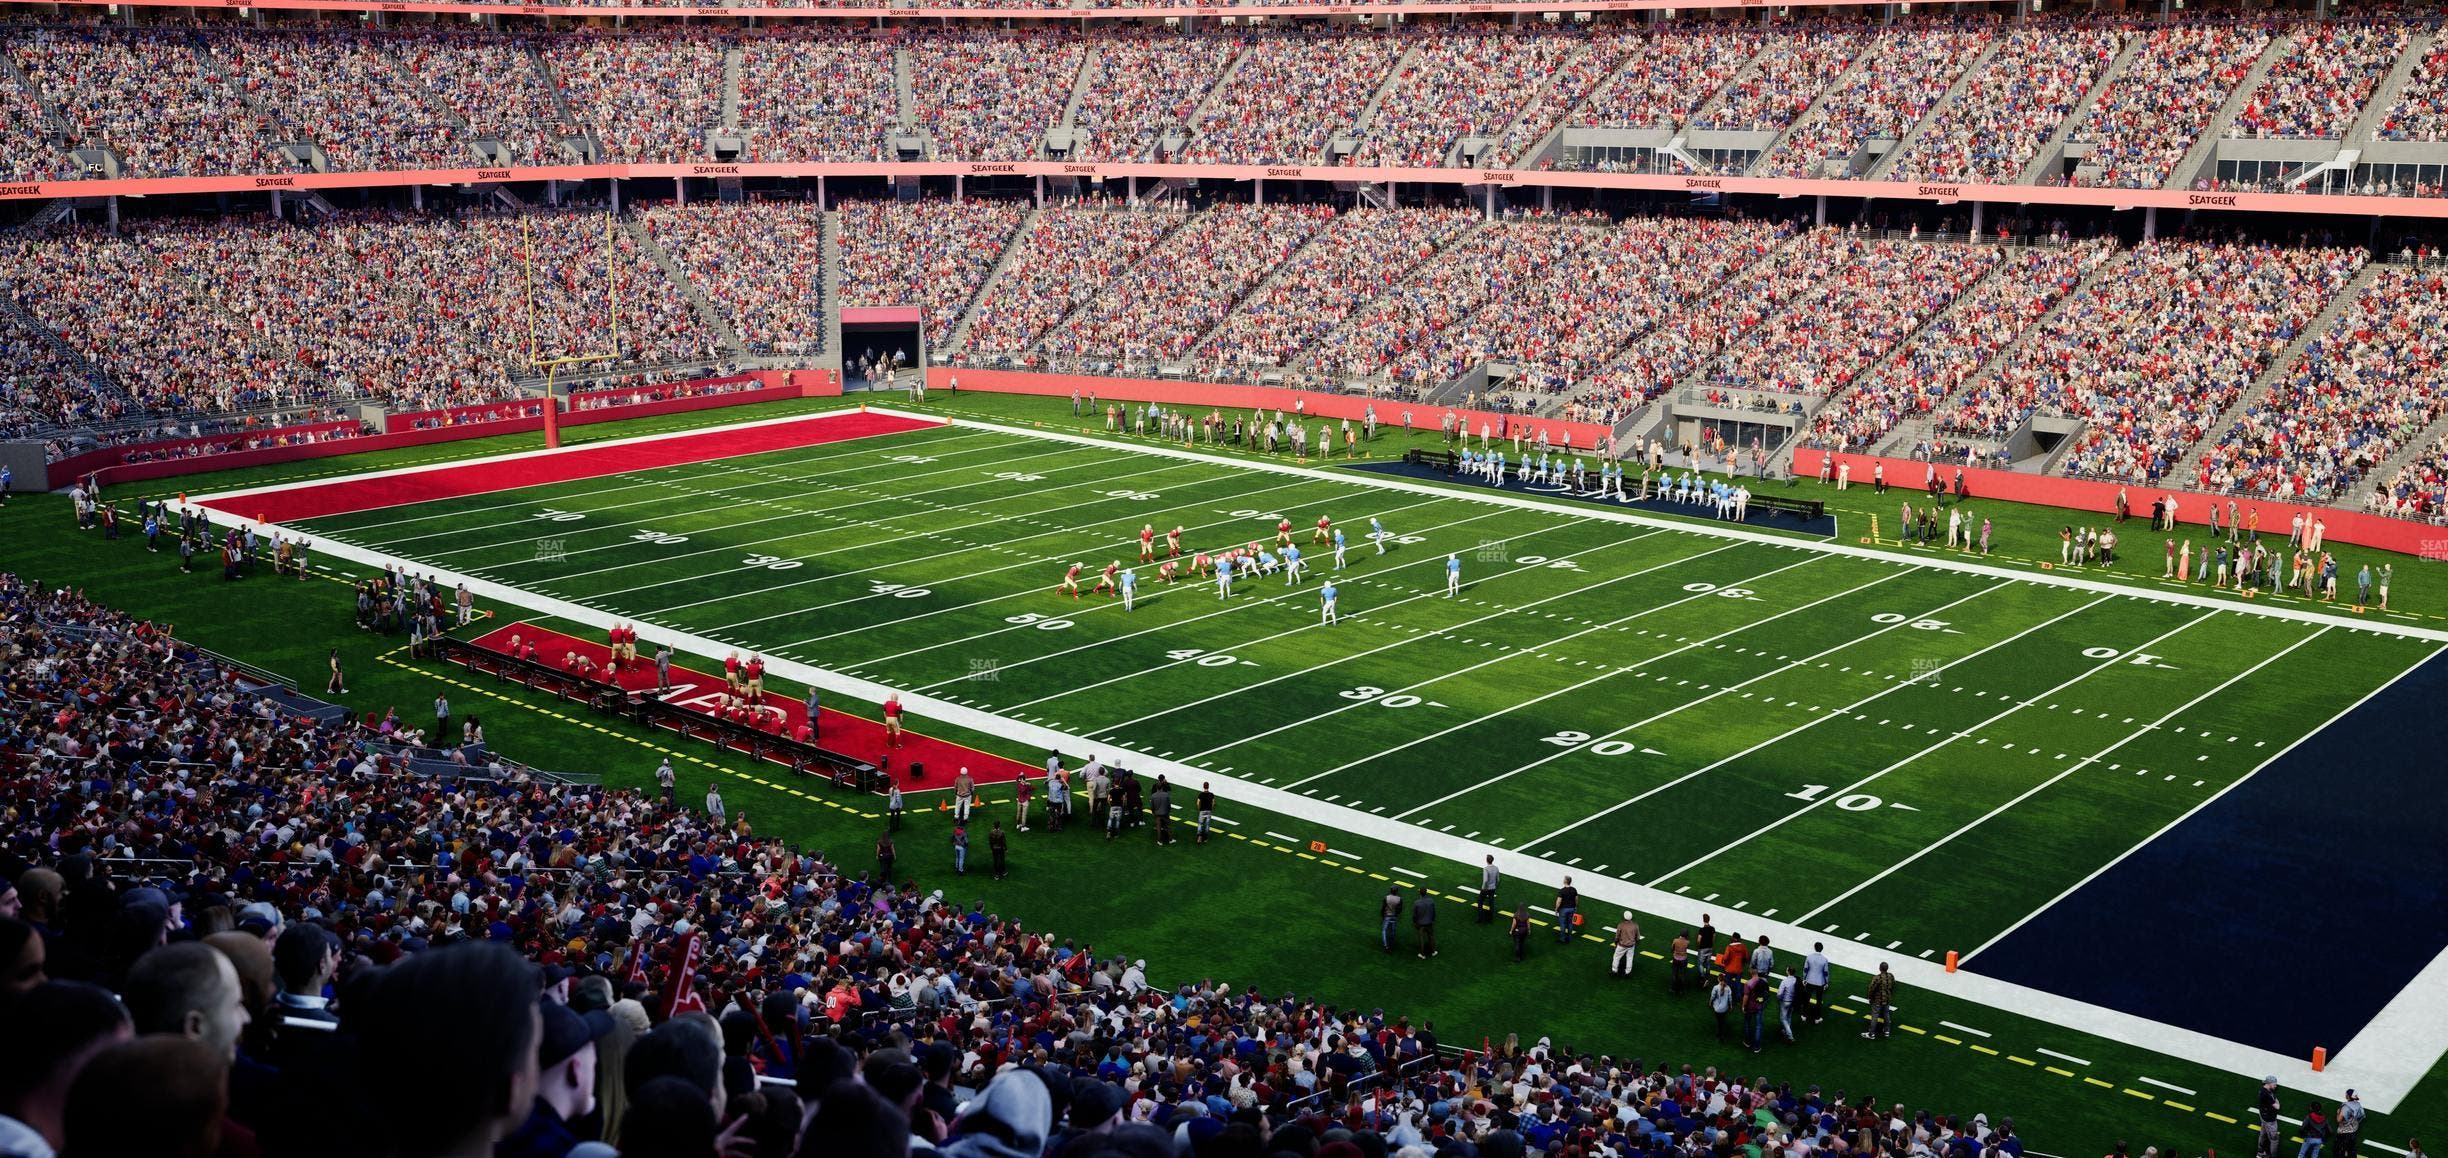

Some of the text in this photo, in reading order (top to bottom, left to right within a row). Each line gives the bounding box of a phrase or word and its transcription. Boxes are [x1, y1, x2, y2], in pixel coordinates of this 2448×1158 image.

[694, 166, 739, 174] SEATGEEK
[972, 165, 1015, 173] SEATGEEK
[1065, 165, 1096, 173] SEATGEEK
[1267, 169, 1302, 177] SEATGEEK
[478, 171, 511, 180] SEATGEEK
[1484, 173, 1515, 182] SEATGEEK
[256, 178, 293, 187] SEATGEEK
[1686, 179, 1721, 188] SEATGEEK
[1919, 186, 1959, 197] SEATGEEK
[2189, 195, 2236, 207] SEATGEEK
